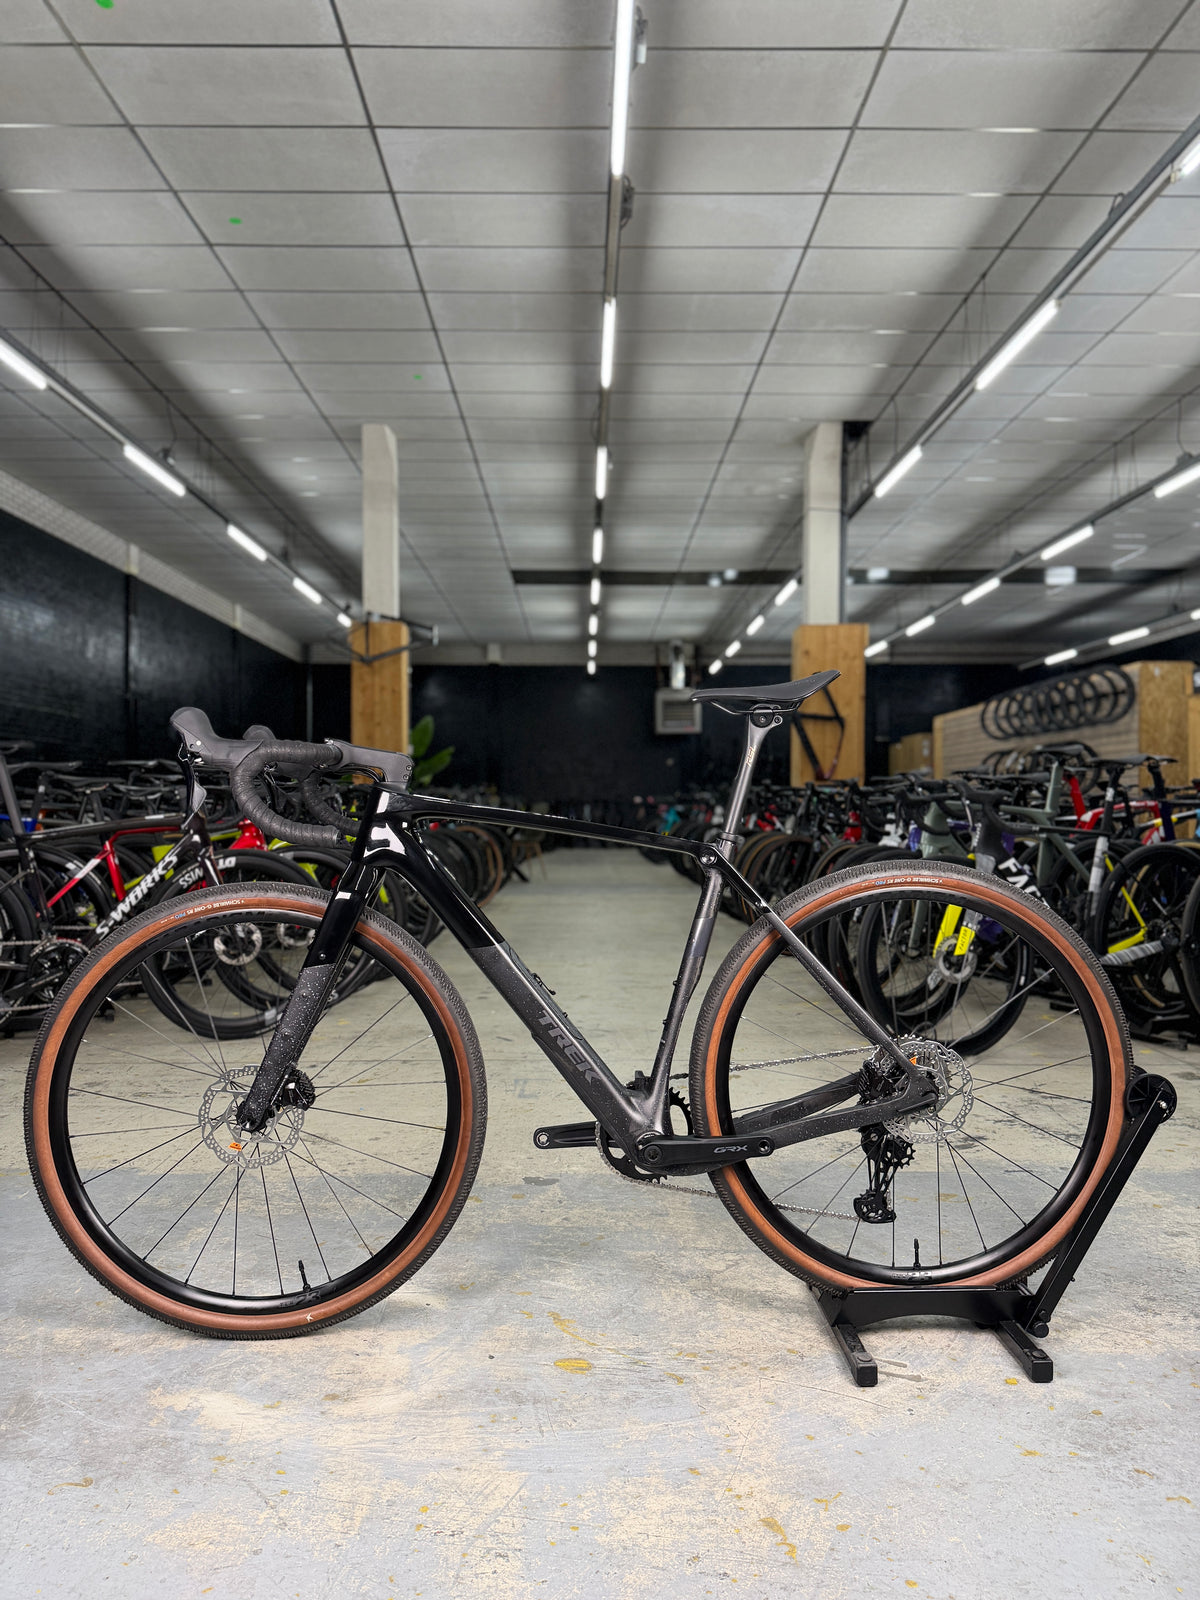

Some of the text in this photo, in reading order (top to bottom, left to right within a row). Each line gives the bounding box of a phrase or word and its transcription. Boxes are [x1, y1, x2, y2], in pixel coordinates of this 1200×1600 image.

[180, 867, 204, 889] WISS
[95, 853, 178, 939] S-WORKS
[213, 899, 240, 909] SCHWALBE
[194, 904, 212, 914] G-ONE
[538, 1009, 602, 1086] TREK
[713, 1144, 748, 1154] GRX
